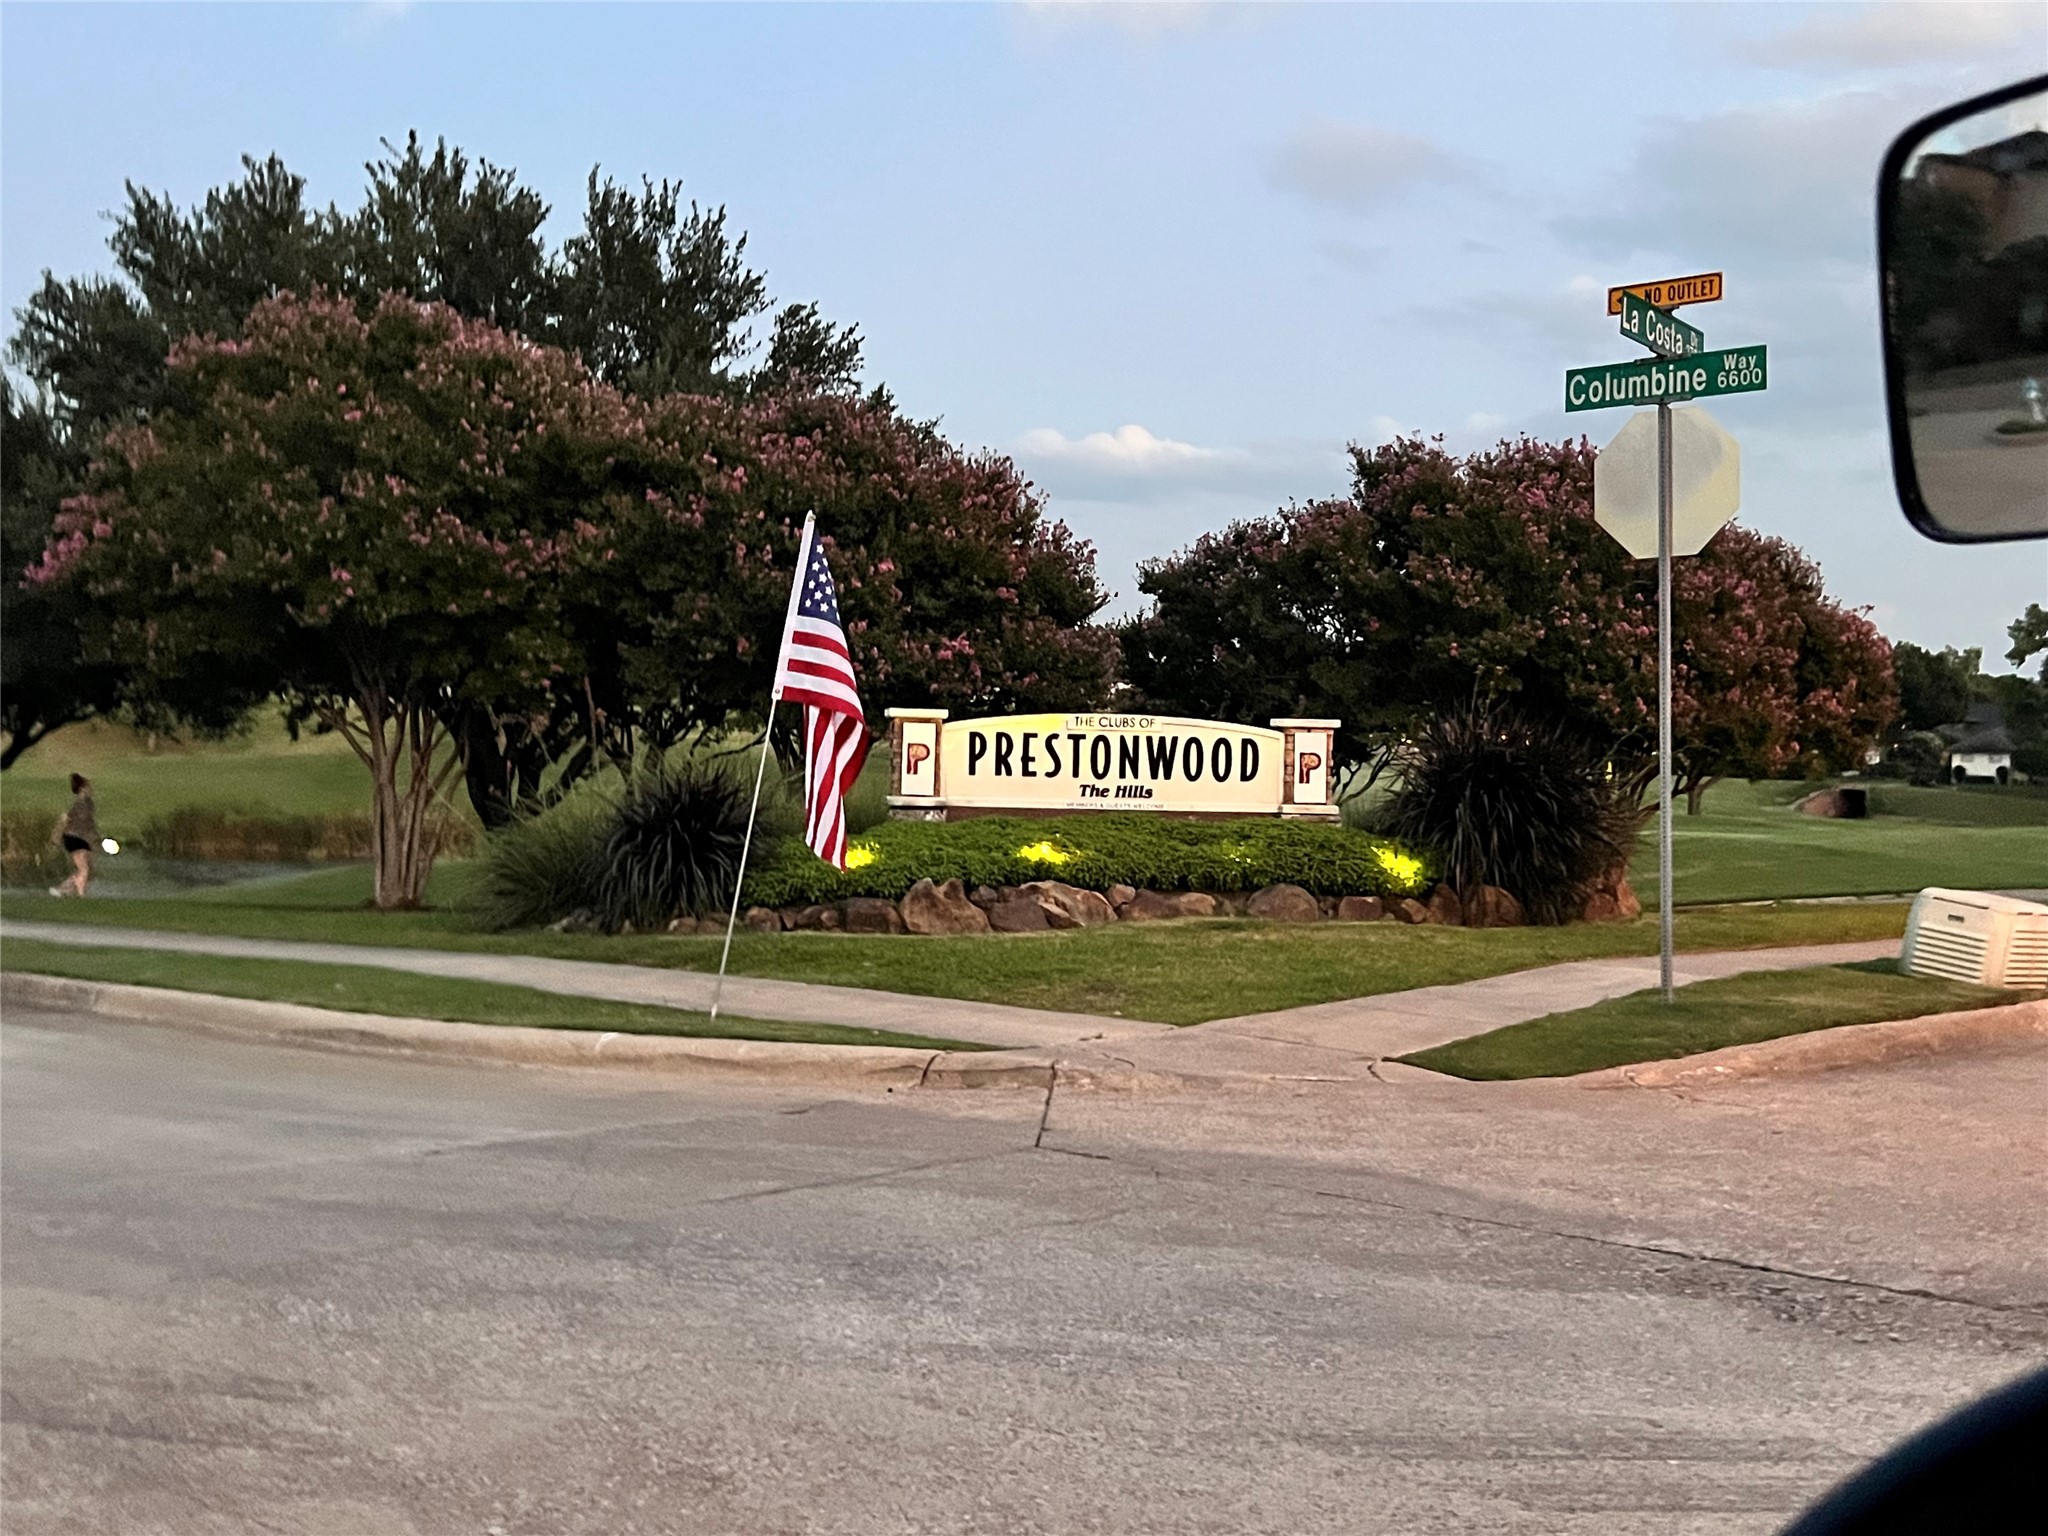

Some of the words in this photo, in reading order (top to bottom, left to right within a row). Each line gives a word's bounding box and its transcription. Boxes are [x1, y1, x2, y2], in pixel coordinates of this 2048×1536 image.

[1644, 288, 1661, 304] NO
[1668, 278, 1715, 301] OUTLET
[1622, 296, 1639, 333] La
[1645, 310, 1683, 354] Costa
[1723, 353, 1757, 371] Way
[1569, 364, 1707, 406] Columbine
[1717, 367, 1762, 388] 6600
[1074, 716, 1096, 728] THE
[1098, 716, 1135, 729] CLUBS
[1139, 717, 1156, 730] OF
[968, 731, 1260, 783] PRESTONWOOD
[1079, 783, 1110, 798] The
[1114, 784, 1154, 799] Hills
